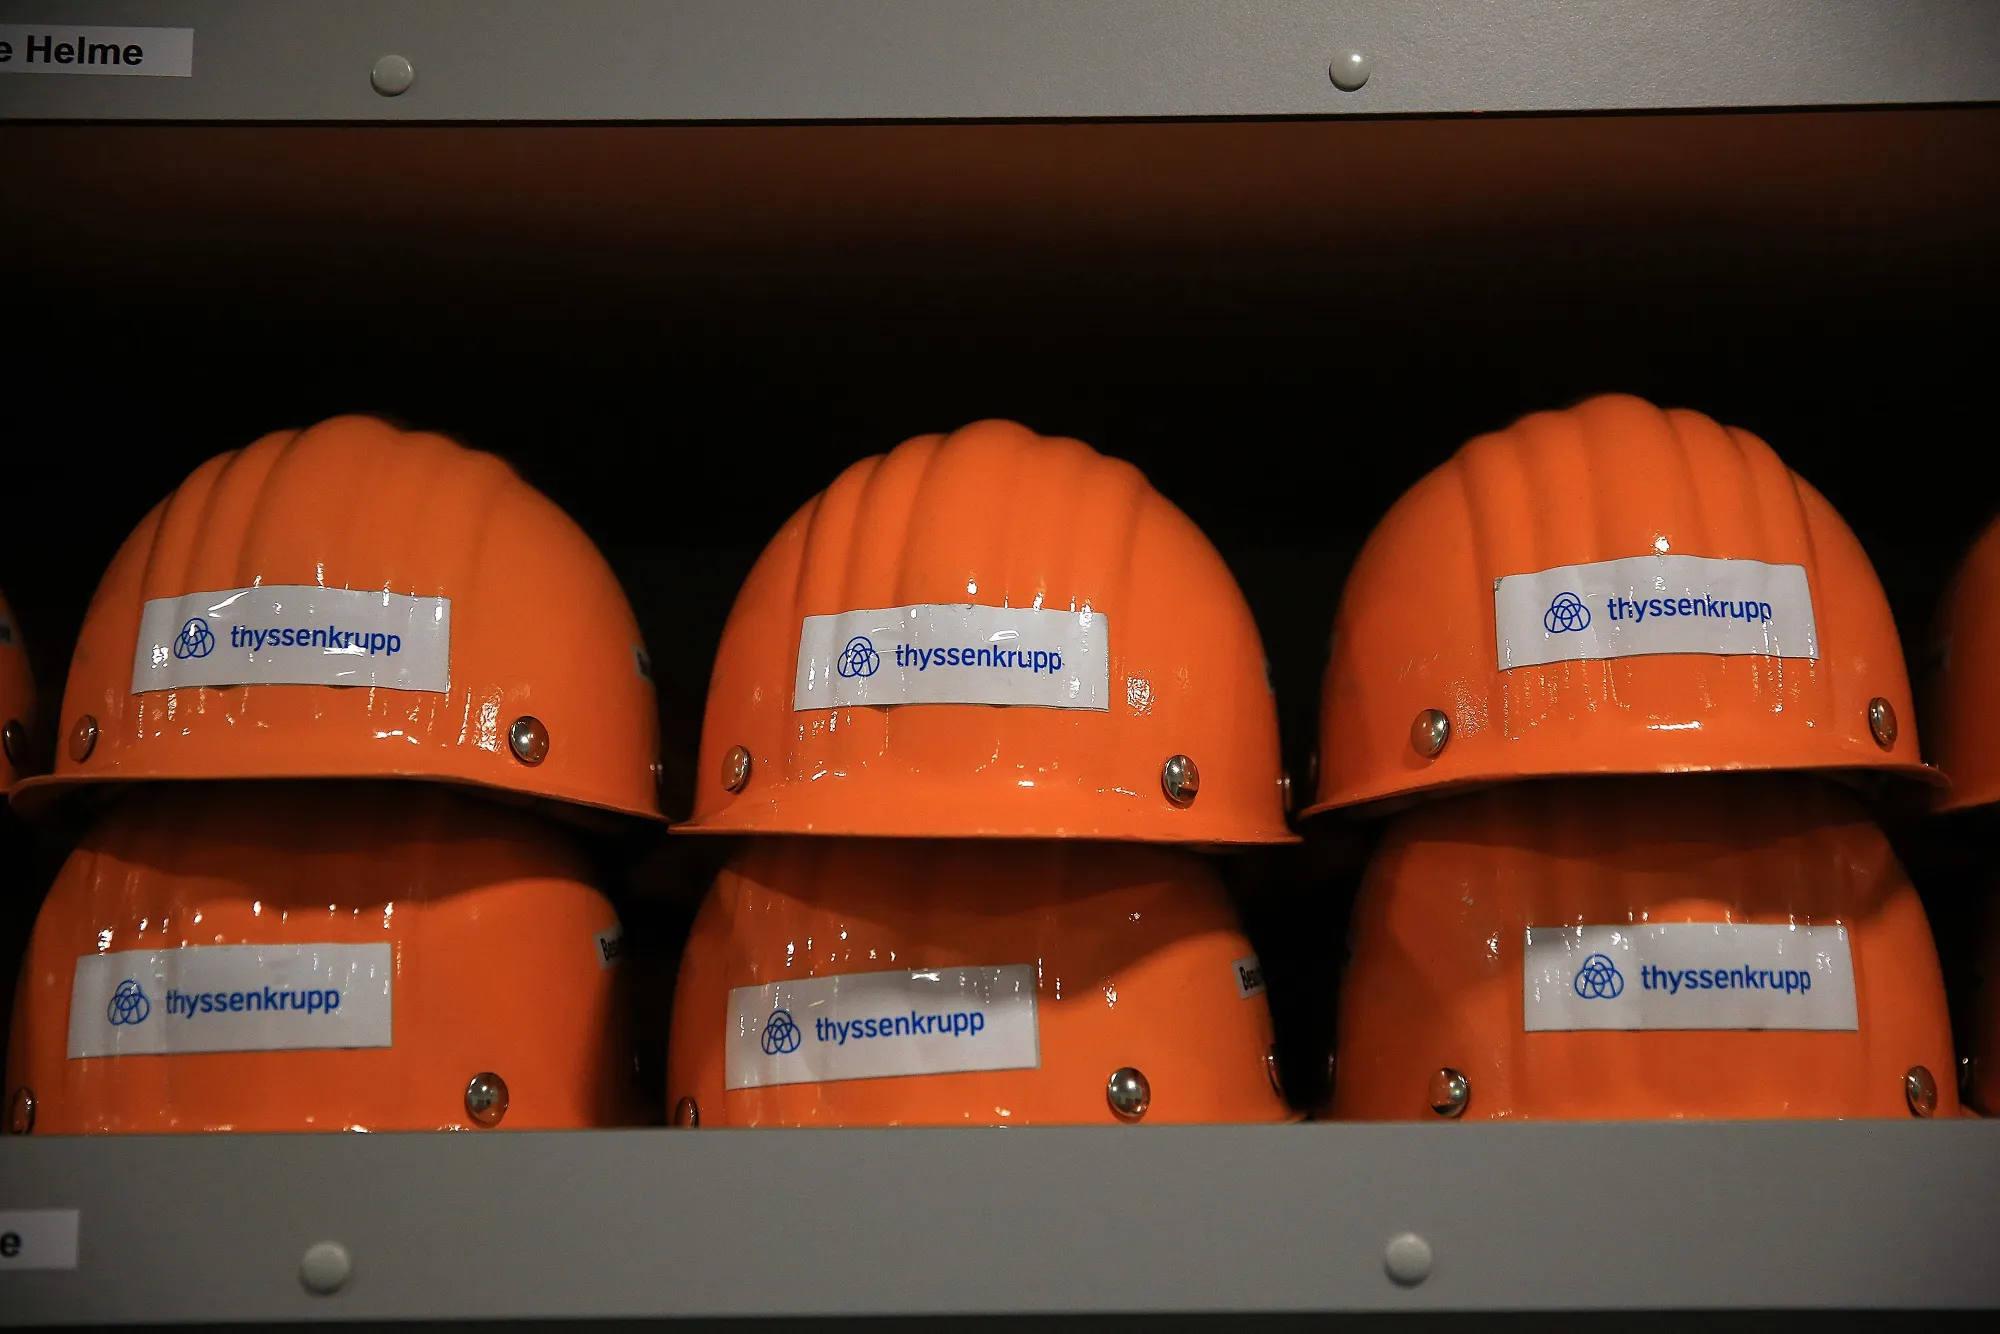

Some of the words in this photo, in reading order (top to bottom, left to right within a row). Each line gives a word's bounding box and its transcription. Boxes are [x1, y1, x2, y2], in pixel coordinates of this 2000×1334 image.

[26, 35, 143, 66] Helme
[1607, 596, 1772, 623] thyssenkrupp
[231, 624, 402, 656] thyssenkrupp
[895, 643, 1062, 674] thyssenkrupp
[1640, 964, 1811, 994] thyssenkrupp
[164, 987, 341, 1017] thyssenkrupp
[815, 1009, 985, 1045] thyssenkrupp
[0, 1232, 21, 1258] e
